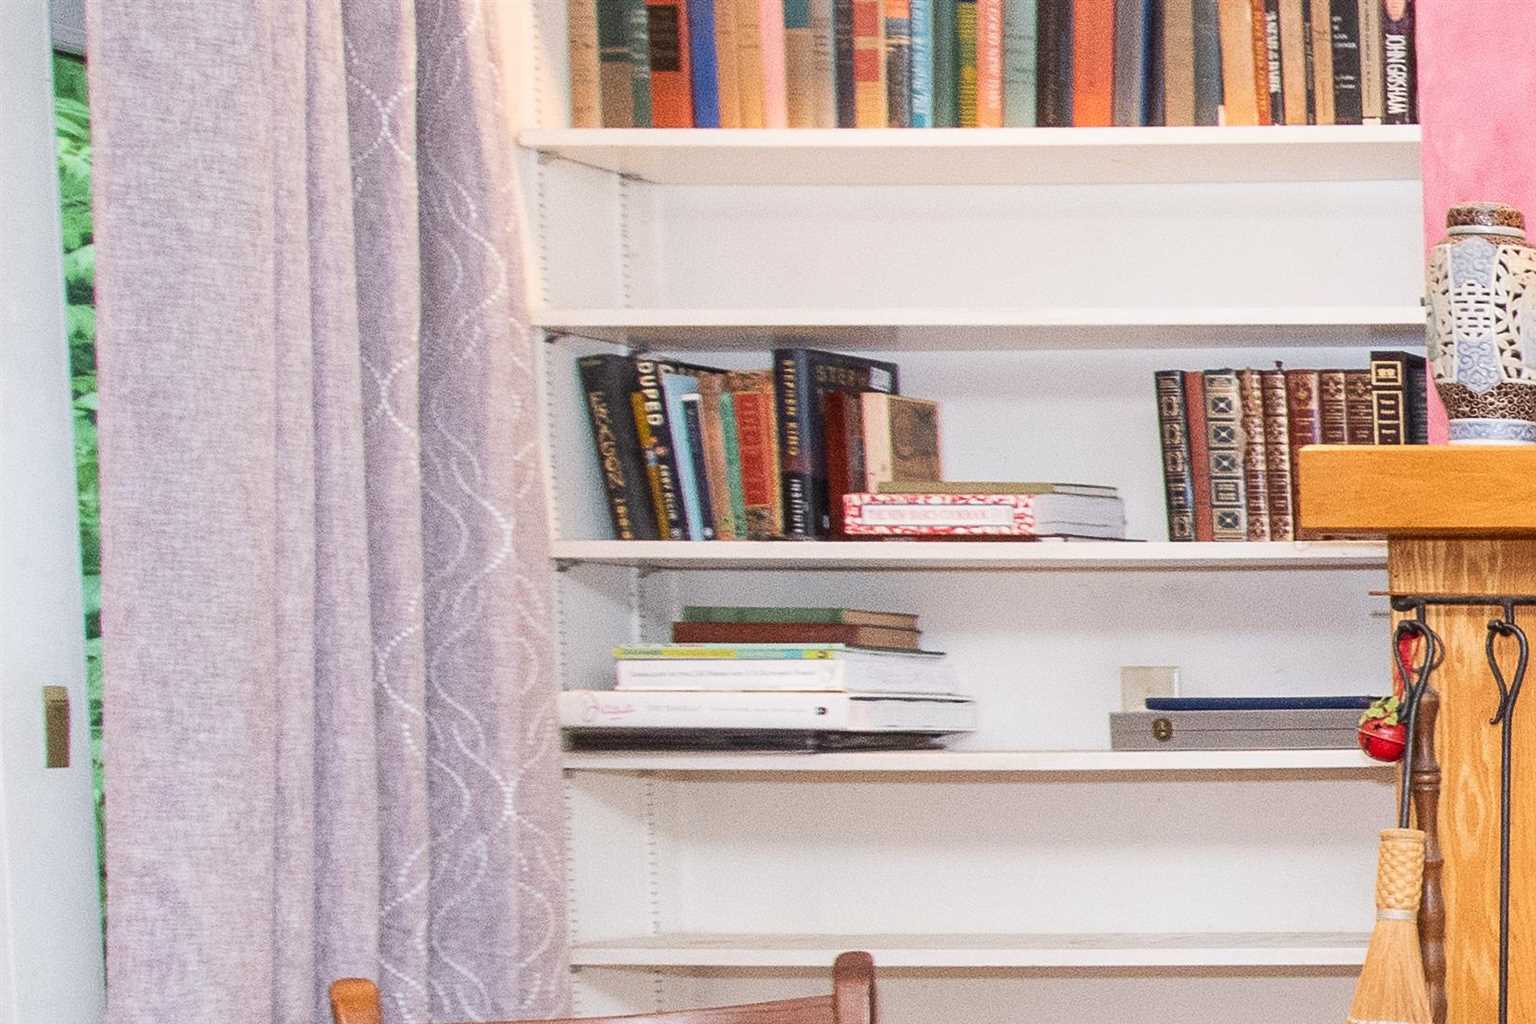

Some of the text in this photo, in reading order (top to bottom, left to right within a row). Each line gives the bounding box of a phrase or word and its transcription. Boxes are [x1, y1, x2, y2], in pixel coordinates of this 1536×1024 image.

[1385, 33, 1409, 114] JOHN GRISHAM
[636, 360, 664, 427] DUPED
